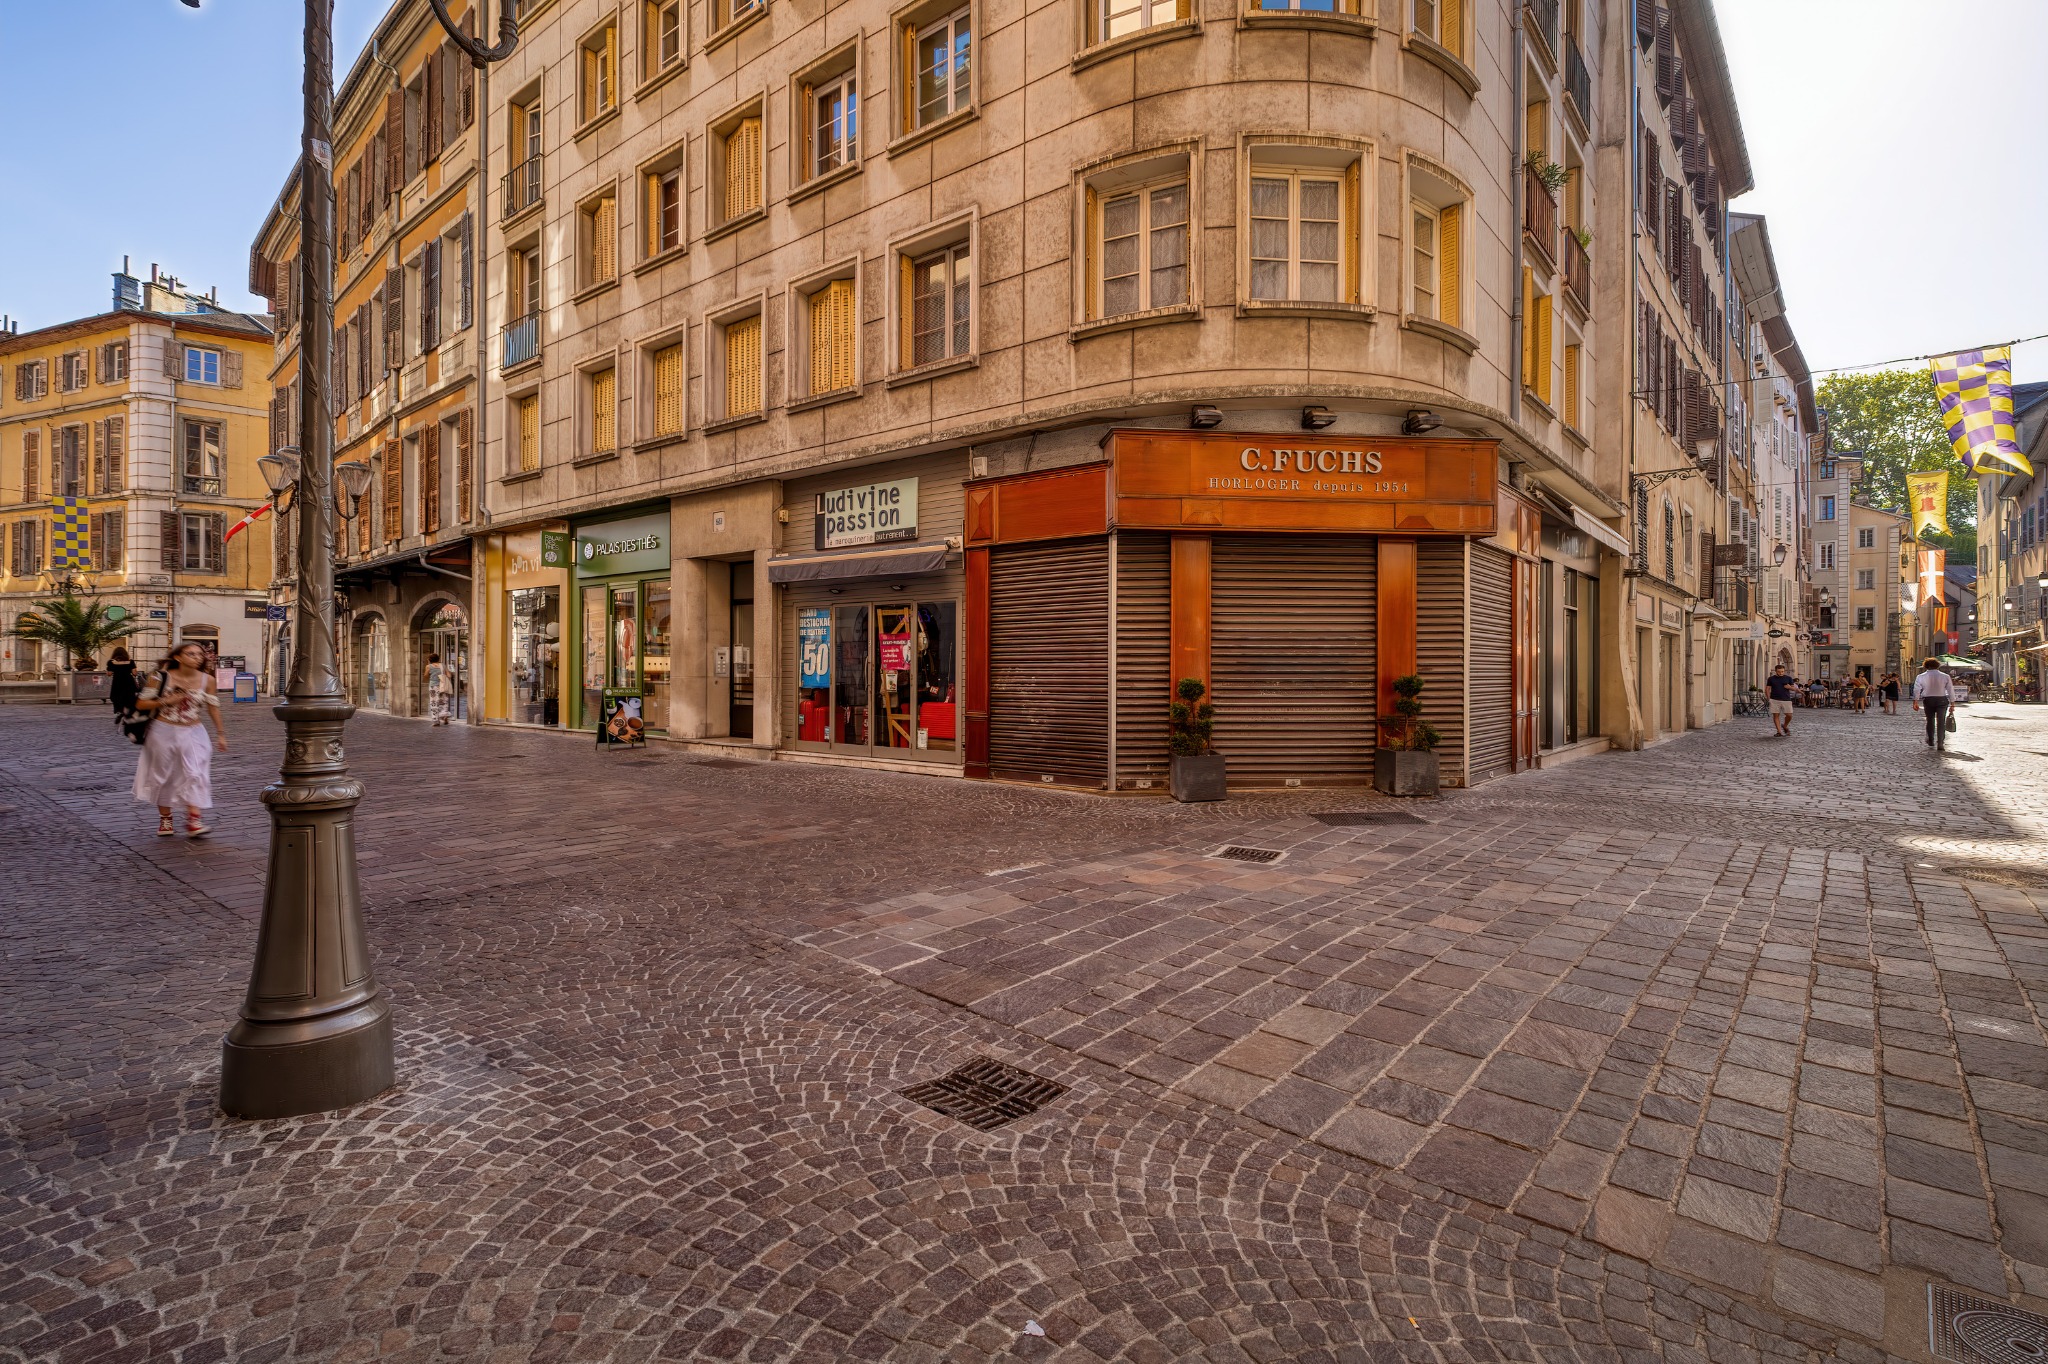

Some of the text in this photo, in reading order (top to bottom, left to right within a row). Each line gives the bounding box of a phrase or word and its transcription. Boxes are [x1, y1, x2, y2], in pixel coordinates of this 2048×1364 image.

[1241, 448, 1383, 474] C.FUCHS
[1208, 478, 1409, 494] HORLOGER depuis 1954
[816, 486, 901, 515] Ludivine
[826, 506, 901, 539] passion
[544, 534, 564, 542] PALAIS
[596, 534, 657, 556] PALAIS DES THÉS
[835, 534, 873, 546] maroquinerie
